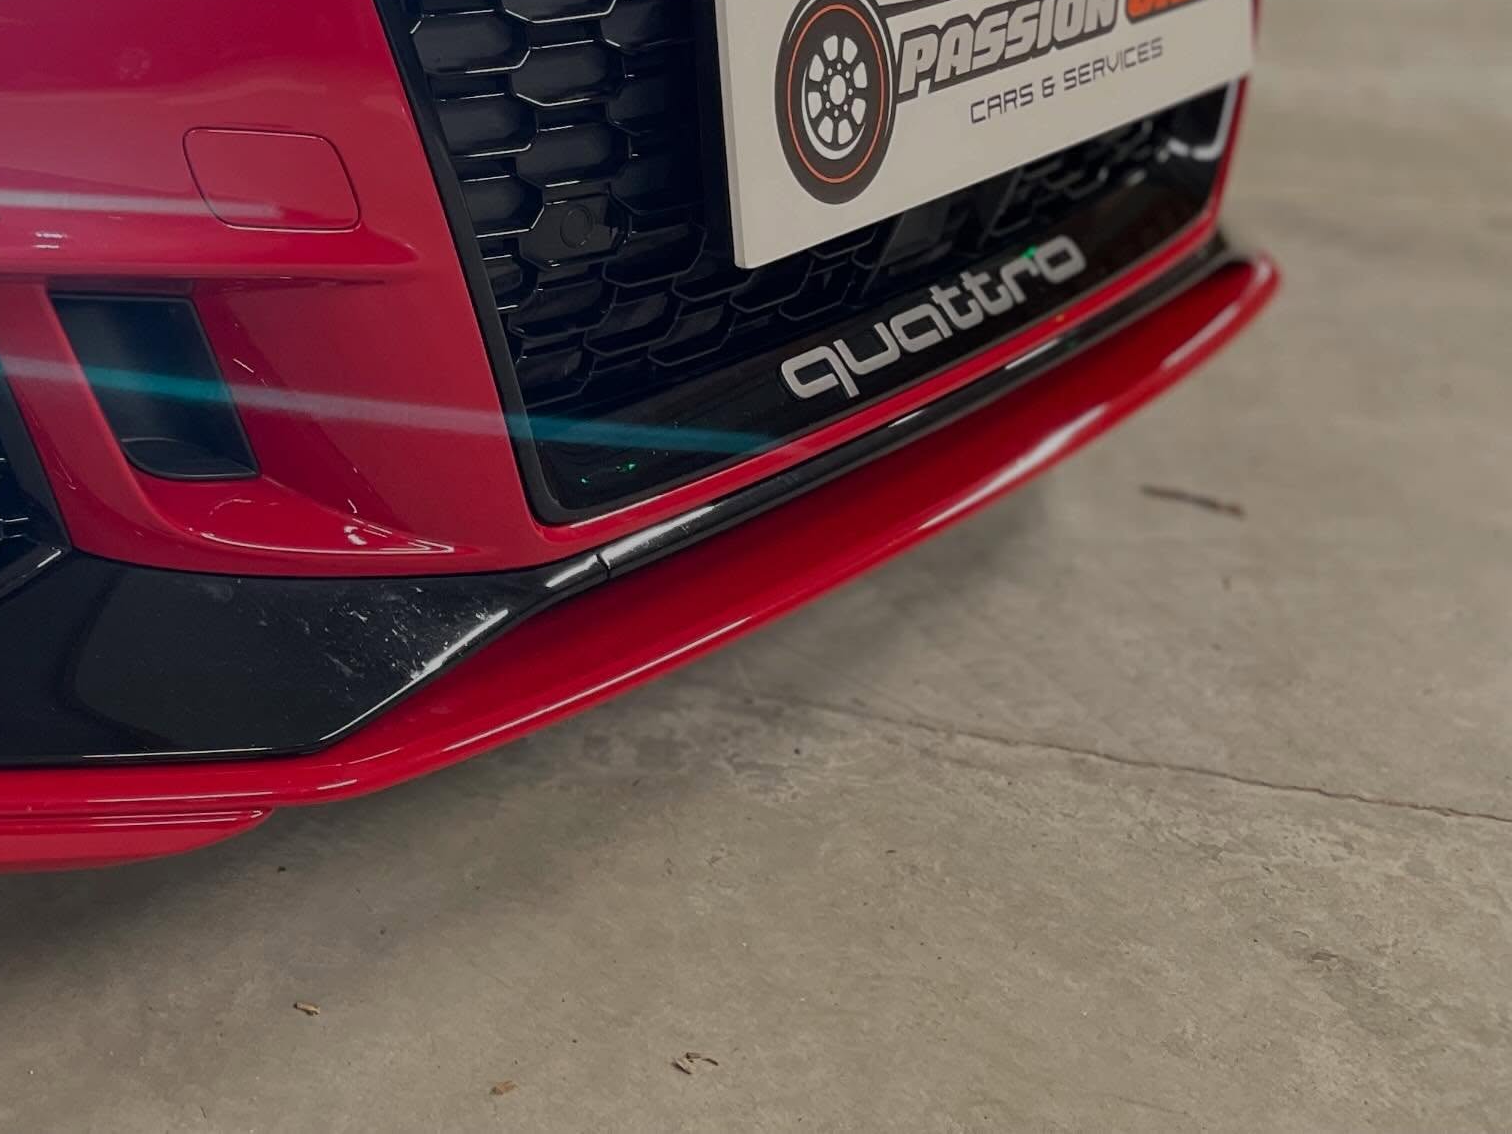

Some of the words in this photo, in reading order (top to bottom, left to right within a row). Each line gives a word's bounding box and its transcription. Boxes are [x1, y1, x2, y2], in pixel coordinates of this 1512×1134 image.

[970, 86, 1034, 123] CARS
[1042, 77, 1055, 99] &
[1064, 37, 1163, 91] SERVICES
[781, 235, 1087, 399] quattro
